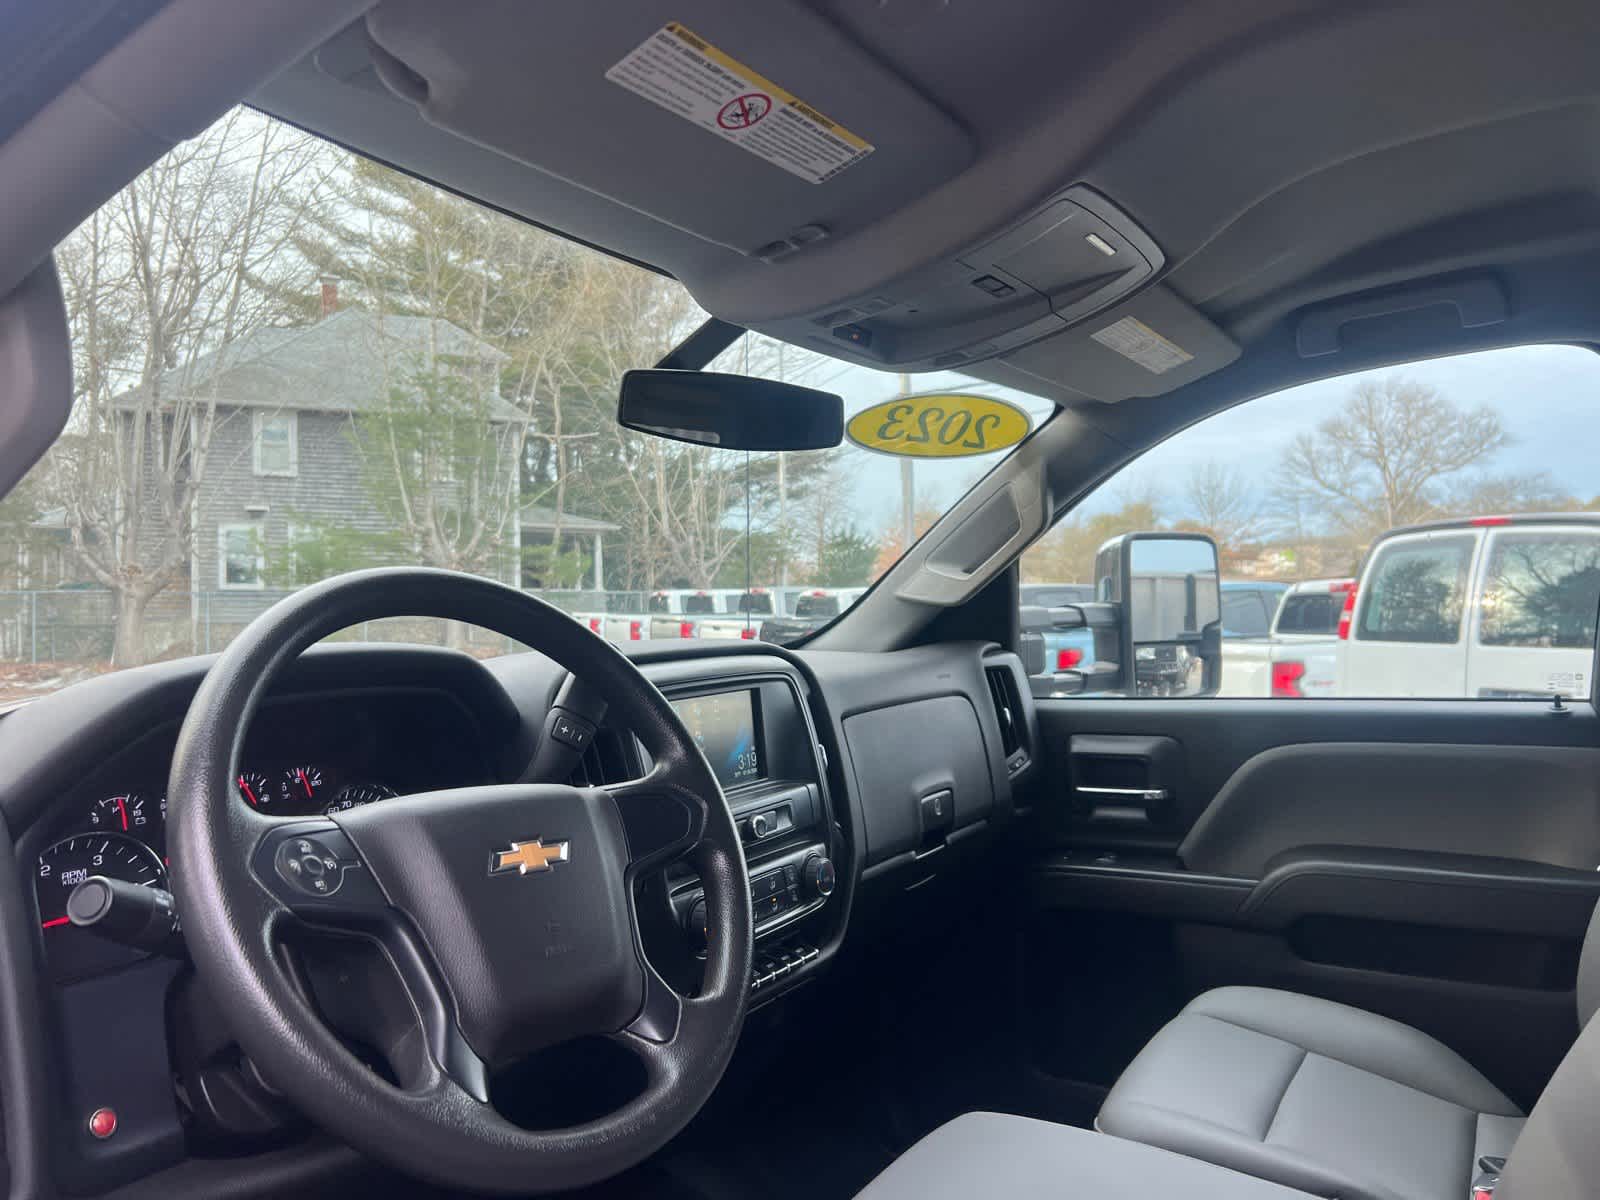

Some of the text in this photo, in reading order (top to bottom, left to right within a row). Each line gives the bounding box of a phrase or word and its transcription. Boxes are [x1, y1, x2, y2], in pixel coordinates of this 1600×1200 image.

[738, 751, 757, 770] 3:19
[92, 854, 104, 866] 3
[40, 864, 51, 877] 2
[62, 868, 87, 880] RPM
